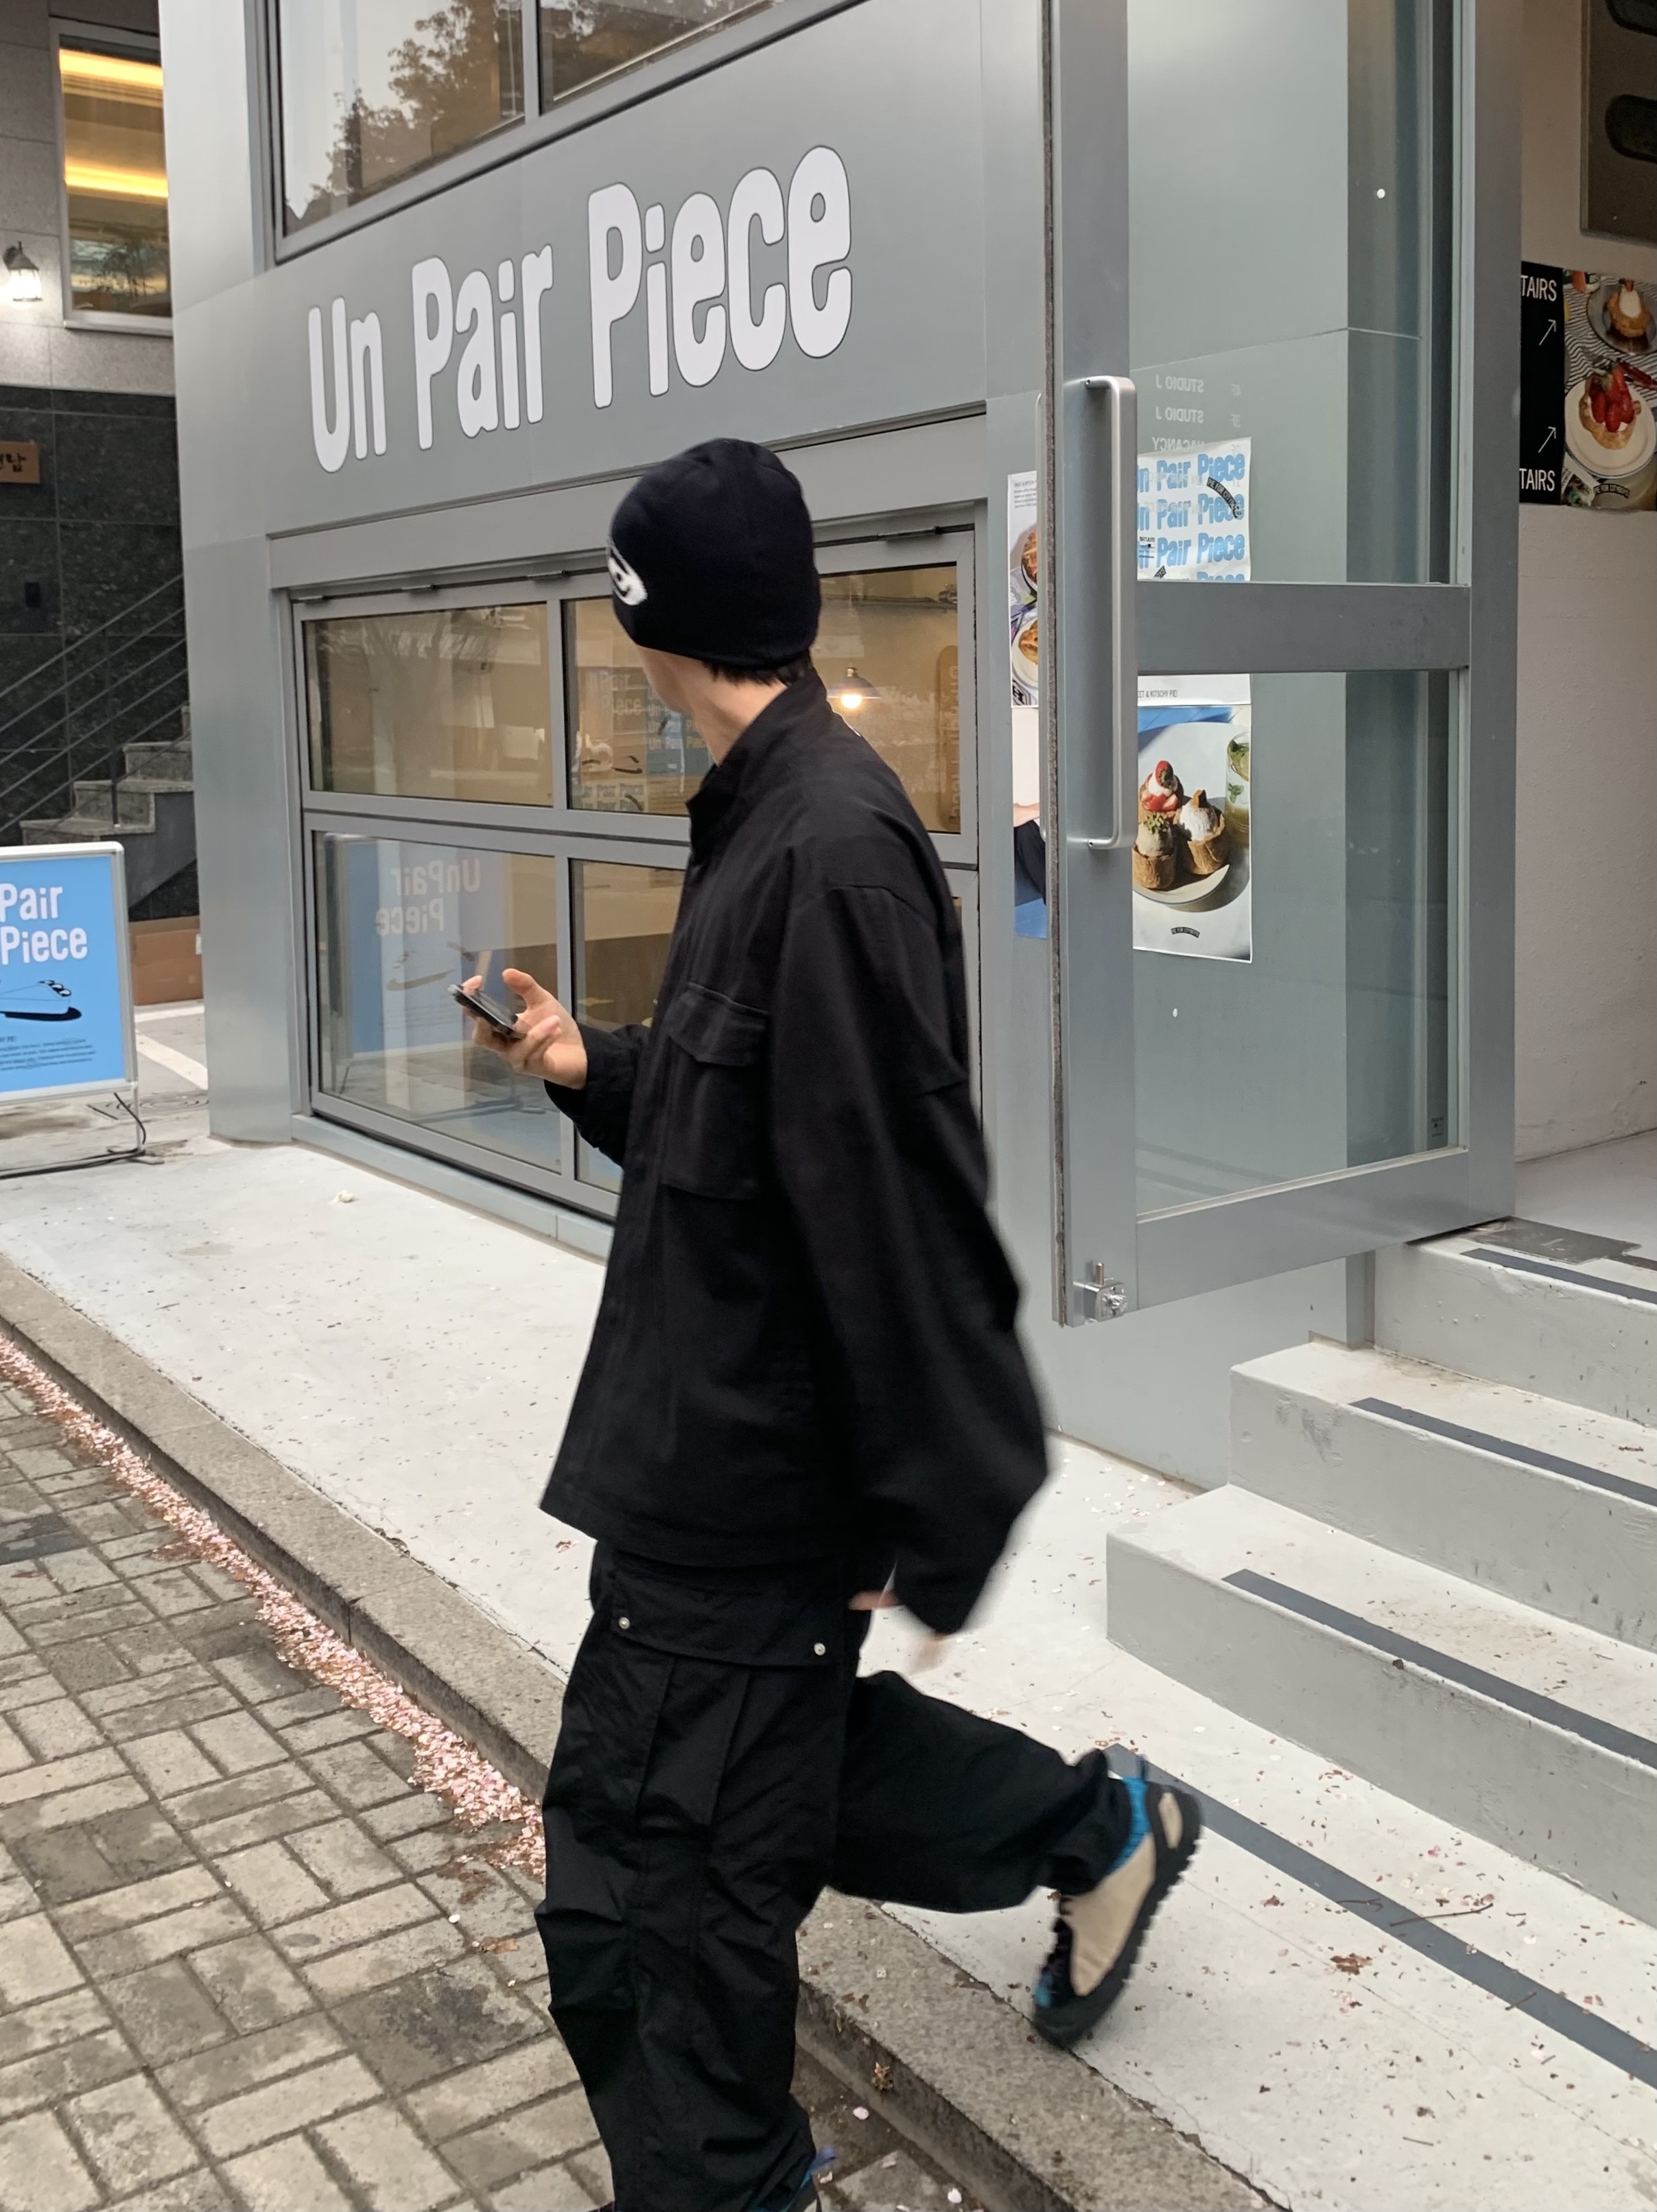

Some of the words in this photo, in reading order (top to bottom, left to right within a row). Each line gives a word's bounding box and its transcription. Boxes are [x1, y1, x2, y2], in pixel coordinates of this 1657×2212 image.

[308, 296, 386, 472] Un
[412, 244, 553, 450] Pair
[587, 145, 853, 409] Piece
[1157, 460, 1191, 491] Pair
[1198, 454, 1245, 485] Piece
[1157, 499, 1191, 530] Pair
[1156, 537, 1191, 568] Pair
[1197, 533, 1245, 563] Piece
[0, 883, 63, 922] Pair
[0, 926, 88, 965] Piece
